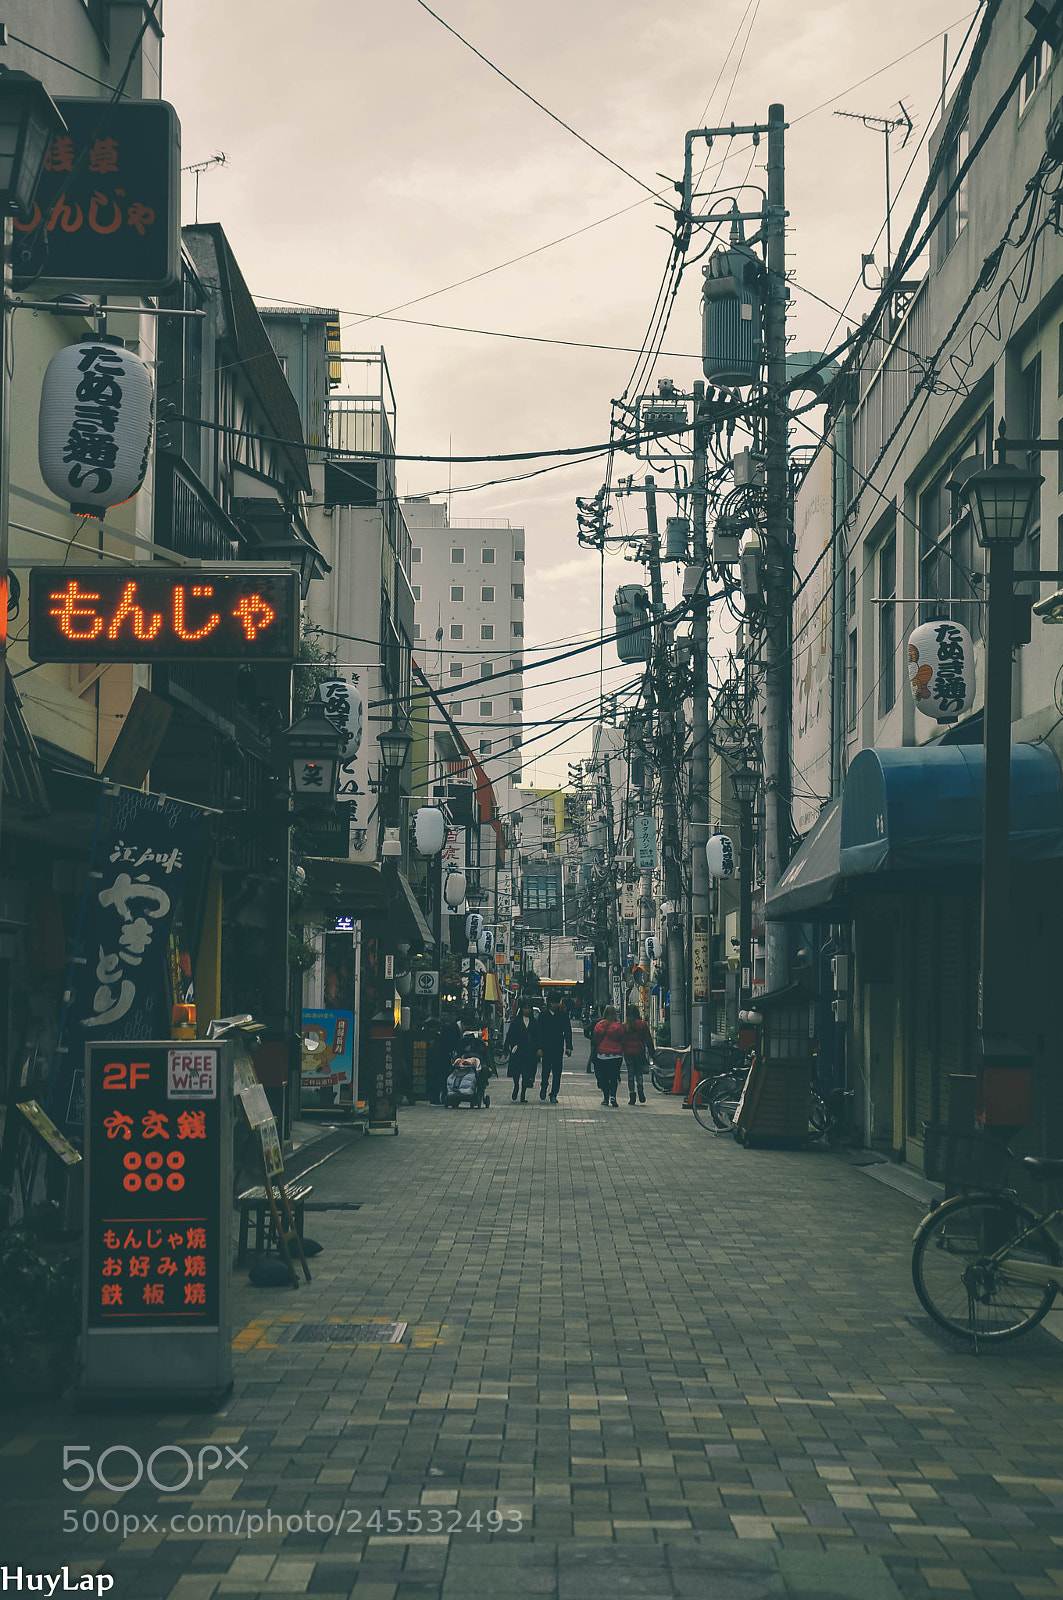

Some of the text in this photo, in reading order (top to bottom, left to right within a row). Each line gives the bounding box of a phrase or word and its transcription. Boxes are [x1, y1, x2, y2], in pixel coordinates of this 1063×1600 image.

[62, 346, 126, 494] たぬき通り
[49, 581, 275, 640] もんじゃ
[932, 623, 967, 712] たぬき通り
[109, 840, 183, 874] 江戸味
[80, 872, 171, 1027] やきとり
[103, 1063, 150, 1090] 2F
[171, 1056, 212, 1072] FREE
[172, 1073, 212, 1090] Wi-Fi
[103, 1110, 207, 1141] 六文銭
[103, 1227, 207, 1250] もんじゃ焼
[102, 1255, 206, 1278] お好み焼
[101, 1283, 206, 1306] 鉄板焼
